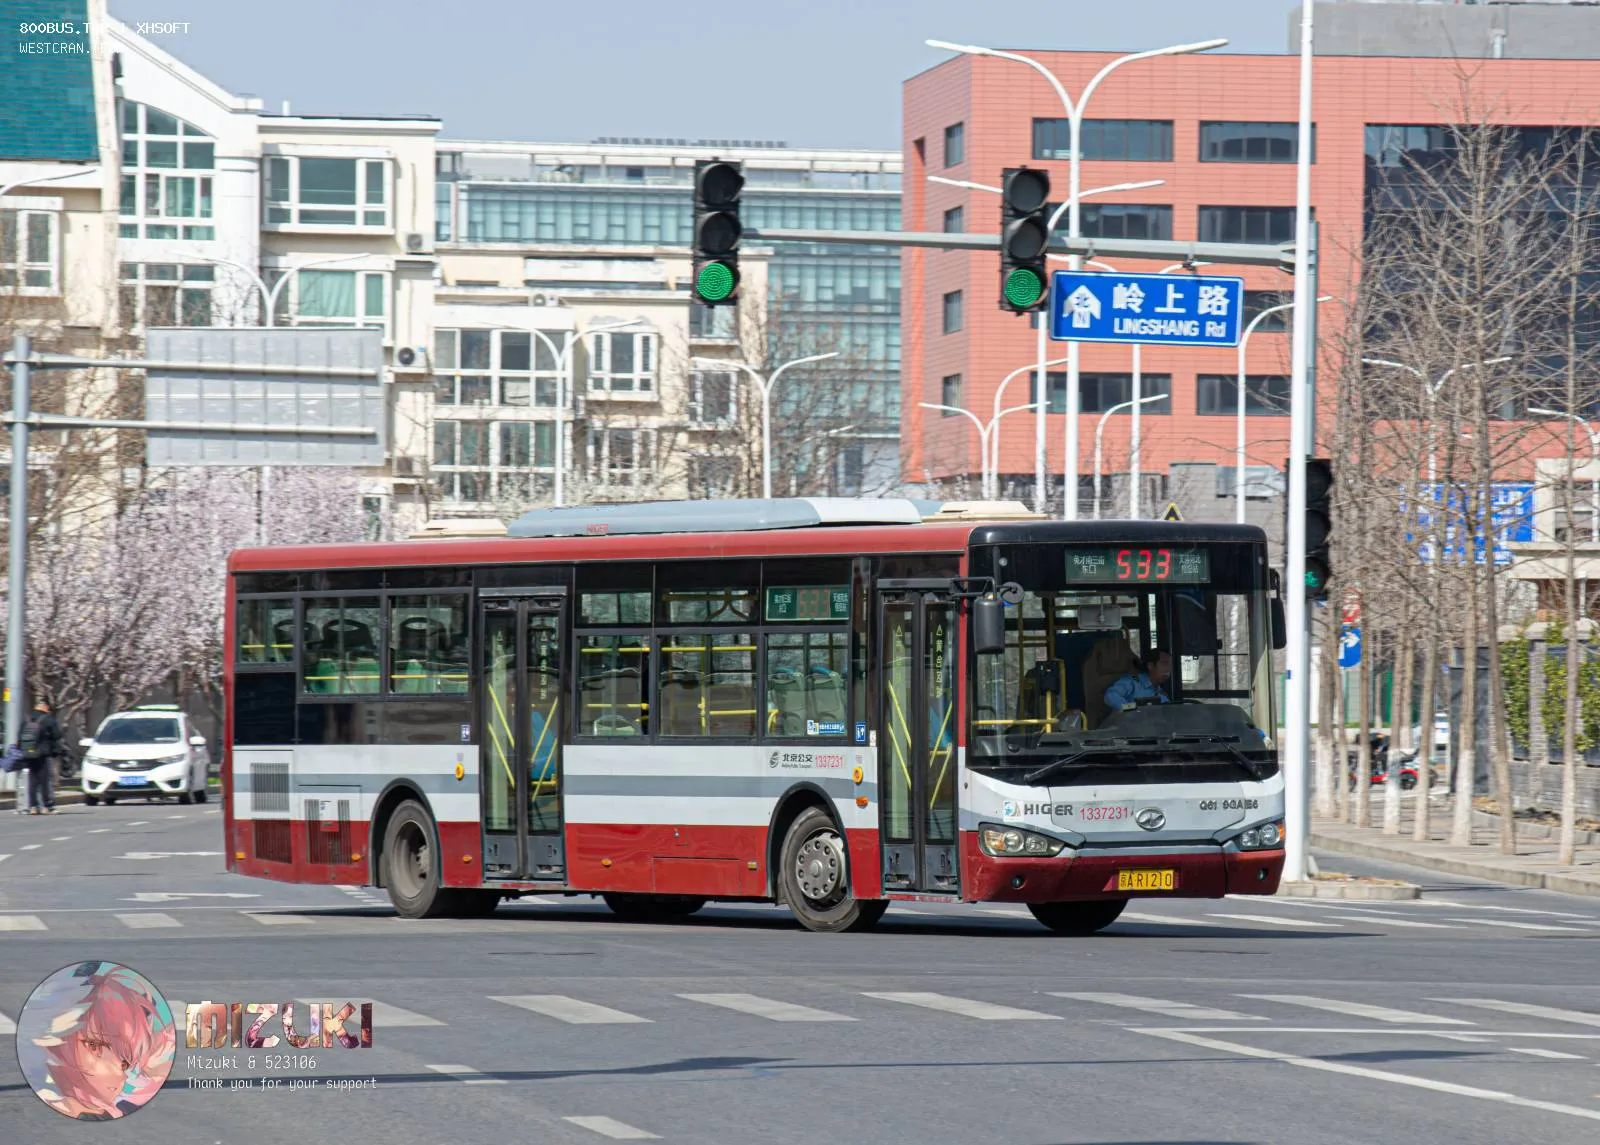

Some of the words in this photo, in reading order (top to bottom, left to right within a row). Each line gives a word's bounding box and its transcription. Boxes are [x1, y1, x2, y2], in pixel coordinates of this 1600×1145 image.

[1112, 282, 1230, 316] 岭上路
[1113, 317, 1200, 337] LINGSHANG
[1205, 320, 1226, 338] Rd
[1117, 550, 1171, 579] 533
[782, 753, 813, 763] 北京公交
[1024, 803, 1073, 816] HIGER
[1079, 806, 1129, 820] 1337231
